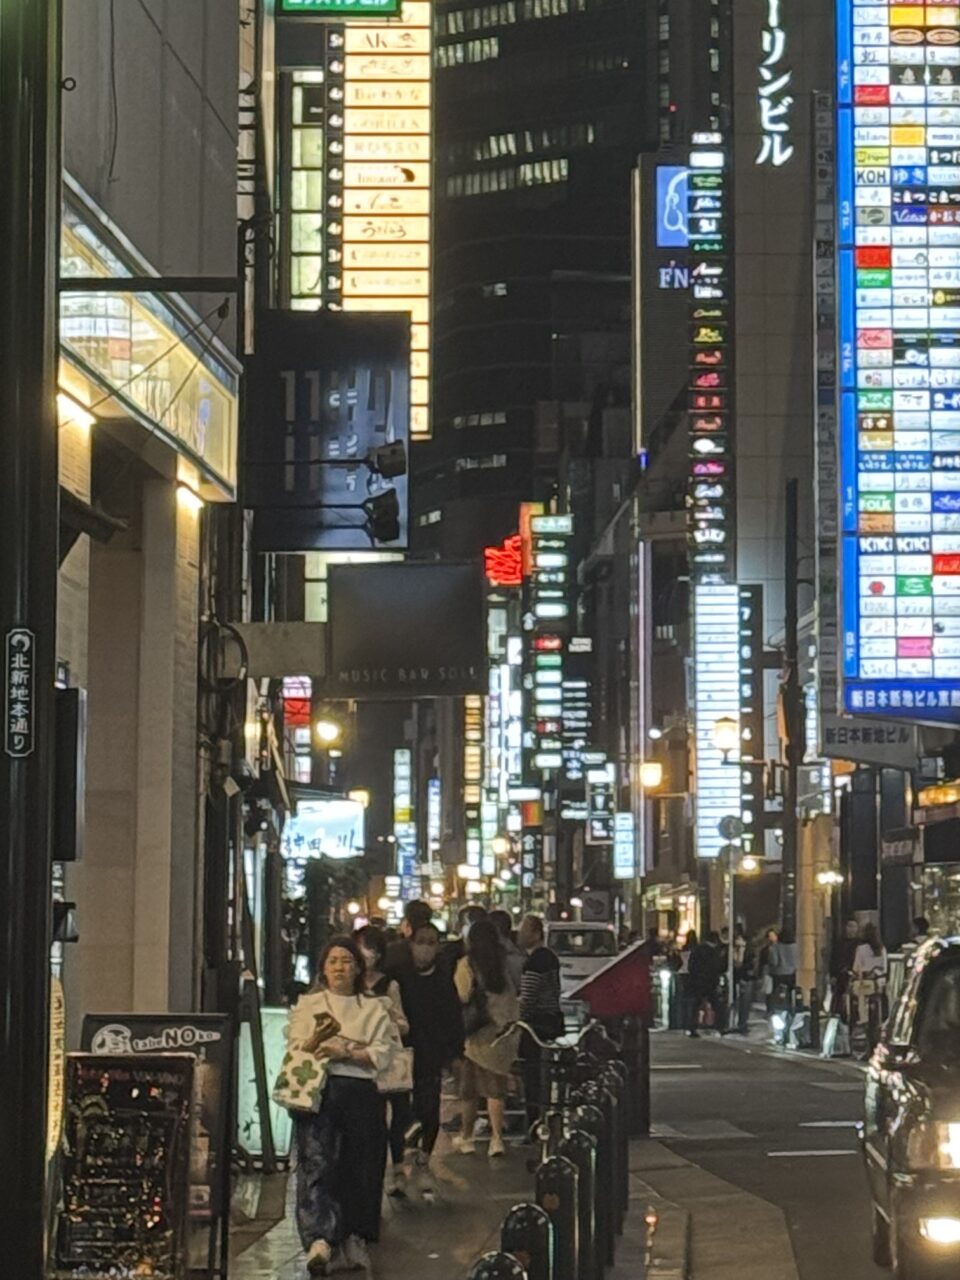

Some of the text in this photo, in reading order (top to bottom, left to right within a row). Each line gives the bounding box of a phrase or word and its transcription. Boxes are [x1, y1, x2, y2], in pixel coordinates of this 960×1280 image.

[9, 652, 31, 751] 北新地本通り
